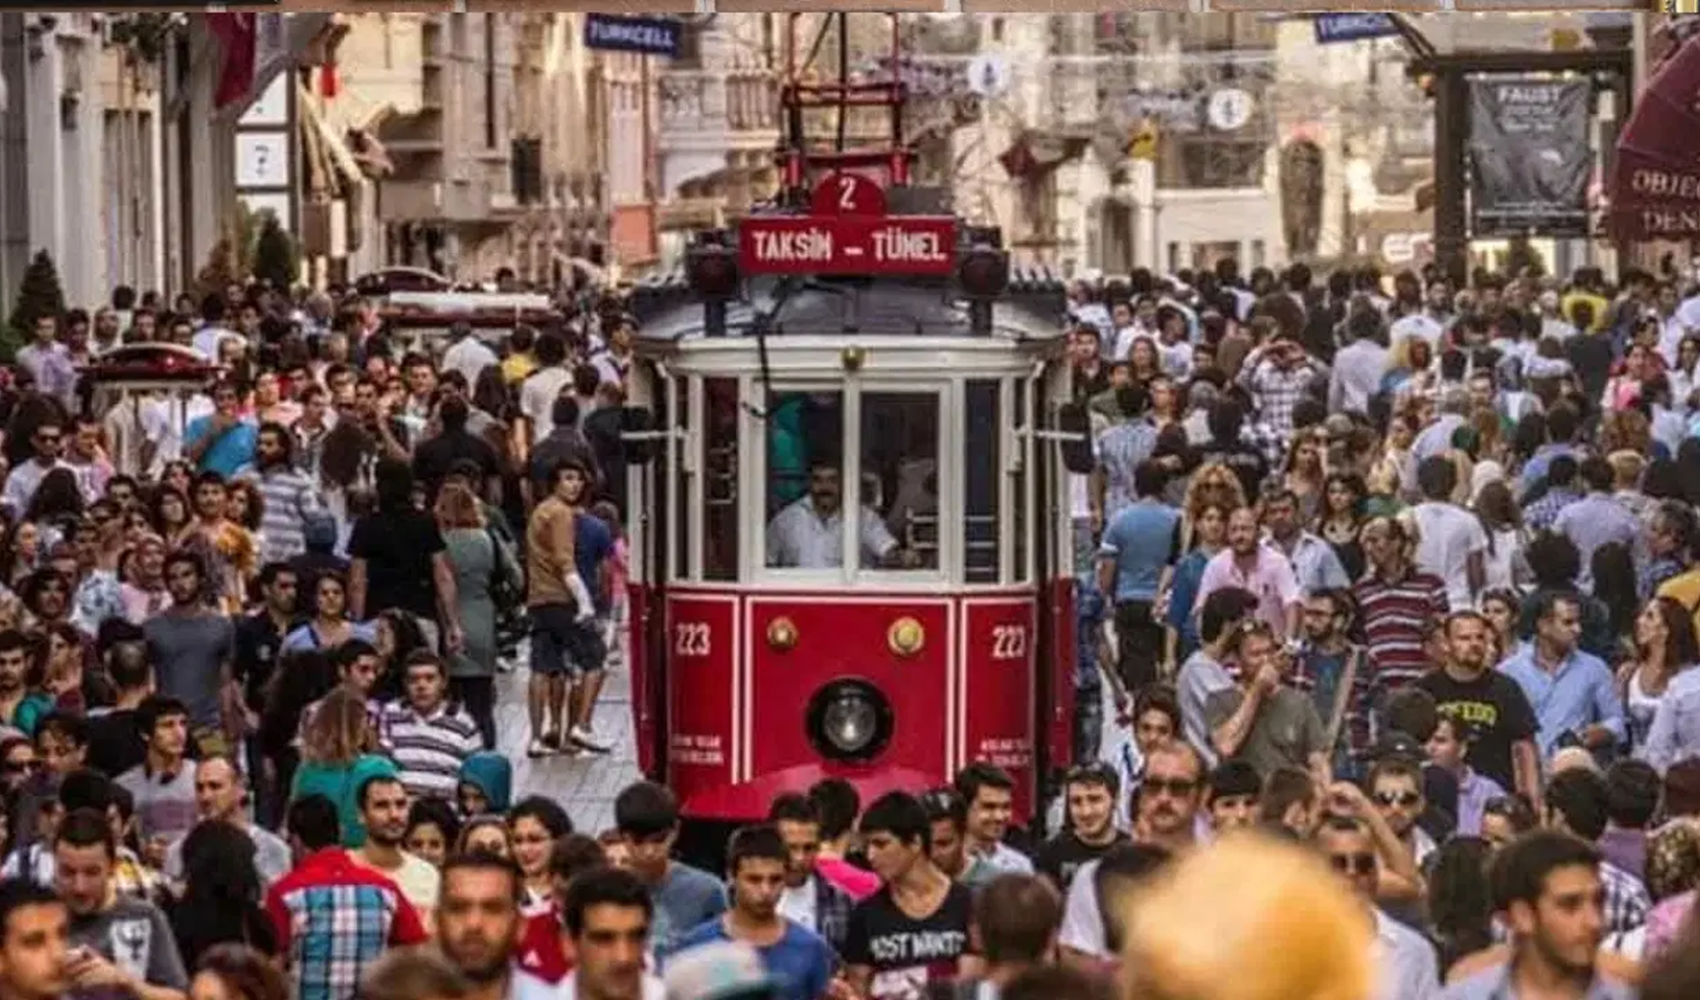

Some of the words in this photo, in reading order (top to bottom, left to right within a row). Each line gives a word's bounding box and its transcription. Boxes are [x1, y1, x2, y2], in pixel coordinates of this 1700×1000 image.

[591, 20, 675, 47] TURKCELL
[1498, 85, 1559, 103] FAUST
[838, 176, 856, 209] 2
[752, 227, 832, 261] TAKSİM
[871, 227, 948, 260] TÜNEL
[675, 622, 712, 656] 223
